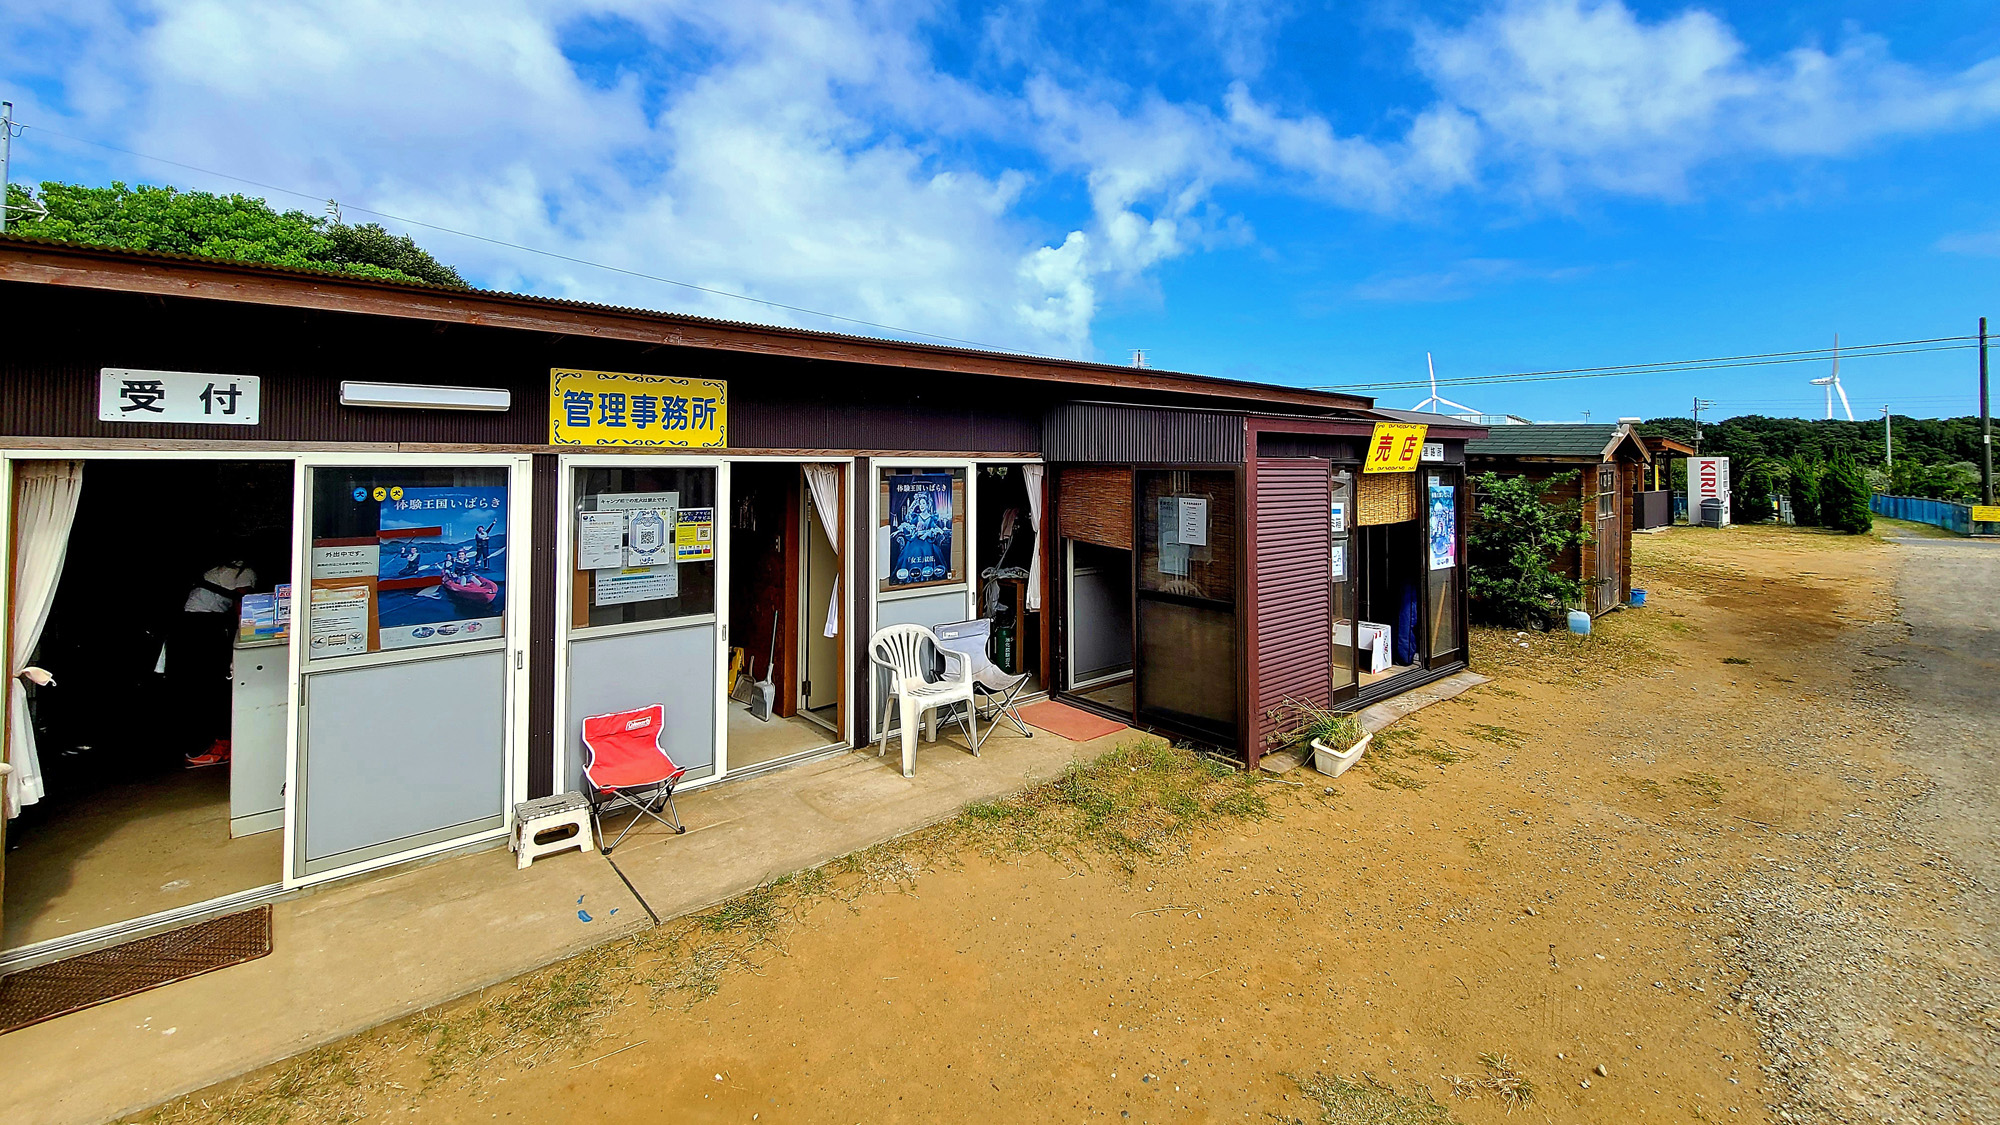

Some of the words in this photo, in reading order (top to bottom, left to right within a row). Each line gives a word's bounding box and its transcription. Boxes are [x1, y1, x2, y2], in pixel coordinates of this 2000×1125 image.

[120, 380, 242, 414] 受付
[563, 389, 717, 431] 管理事務所
[1375, 433, 1418, 461] 売店
[896, 484, 947, 493] 体験王国いばらき
[1700, 461, 1717, 497] KIRI
[394, 497, 501, 511] 体験王国いばらき
[325, 550, 365, 558] 外出中です。
